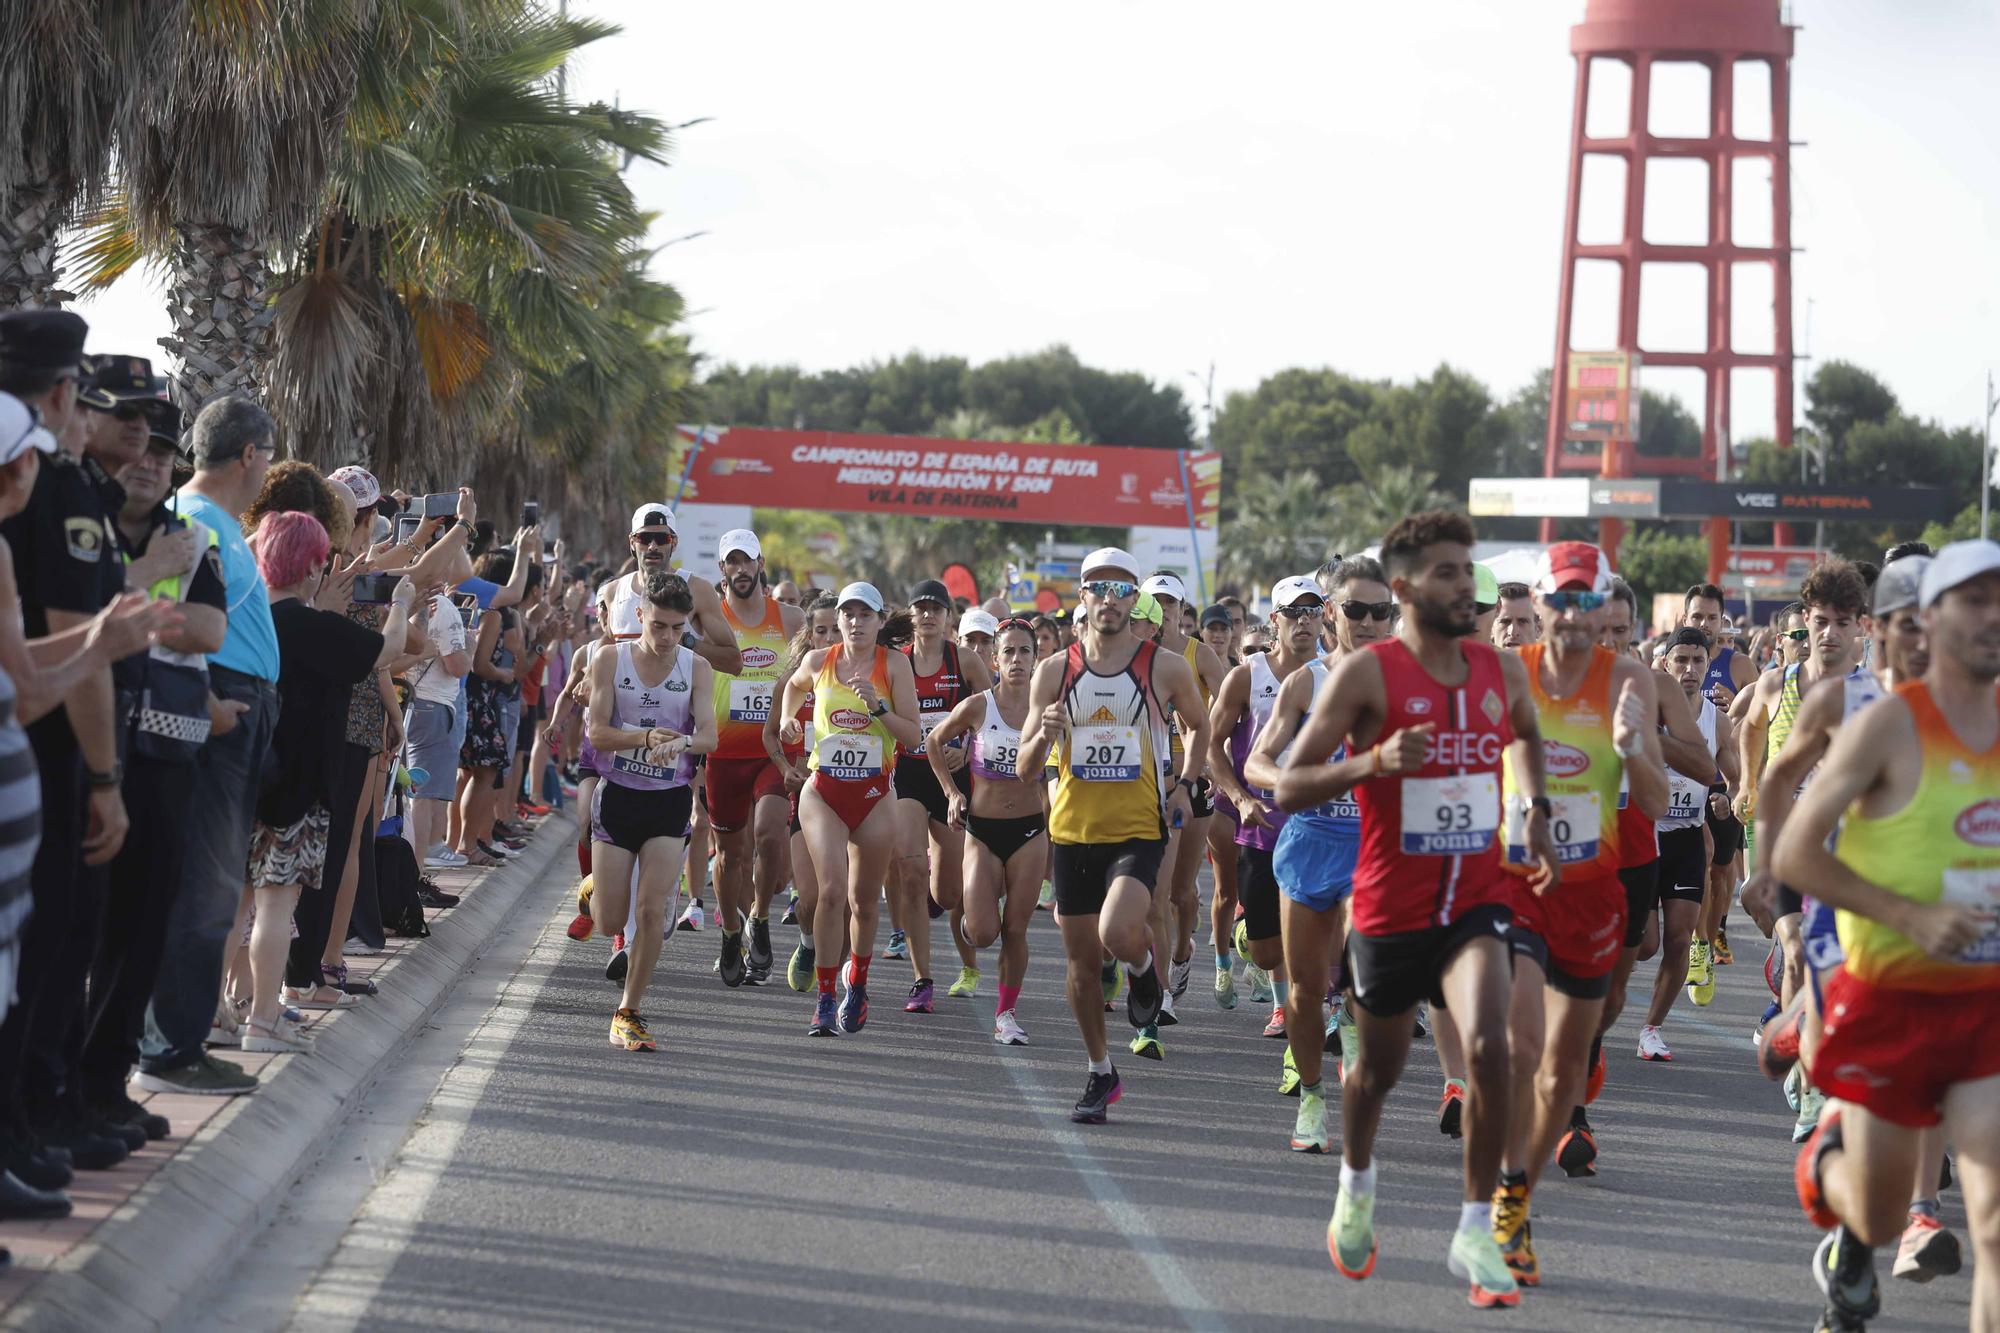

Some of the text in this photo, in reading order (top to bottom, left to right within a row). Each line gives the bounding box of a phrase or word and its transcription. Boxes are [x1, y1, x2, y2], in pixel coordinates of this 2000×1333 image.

[792, 446, 919, 468] CAMPEONATO
[922, 451, 948, 469] DE
[948, 451, 1020, 473] ESPAÑA
[1023, 456, 1051, 475] DE
[1052, 458, 1099, 478] RUTA
[837, 466, 895, 485] MEDIO
[898, 468, 991, 491] MARATÓN
[994, 475, 1009, 491] Y
[867, 489, 1018, 509] VILA DE PATERNA
[743, 696, 772, 710] 163
[835, 715, 867, 724] Serrano
[831, 750, 868, 766] 407
[995, 746, 1019, 762] 39
[1086, 746, 1125, 765] 207
[1436, 804, 1472, 831] 93
